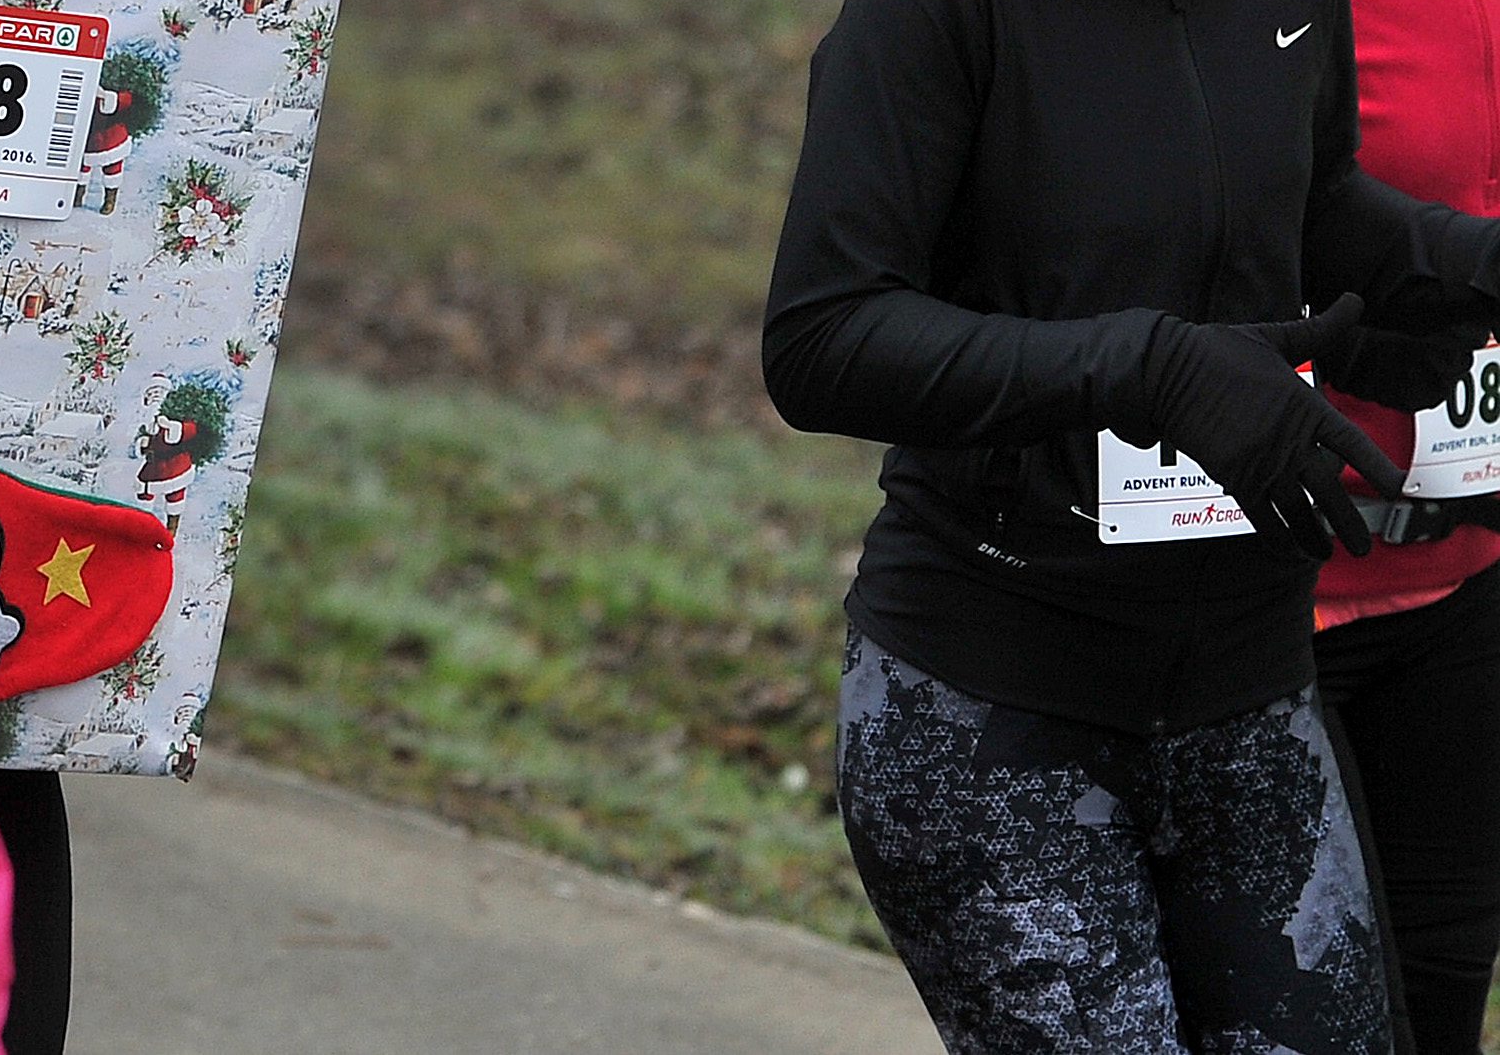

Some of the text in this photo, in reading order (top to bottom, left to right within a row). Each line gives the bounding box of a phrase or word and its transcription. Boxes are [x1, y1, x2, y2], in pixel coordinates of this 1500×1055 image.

[1, 148, 37, 165] 2016.
[1431, 438, 1467, 454] ADVENT
[1123, 475, 1211, 491] ADVENT RUN,
[1171, 508, 1245, 527] RUN CRO
[977, 542, 1028, 568] DRI-FIT
